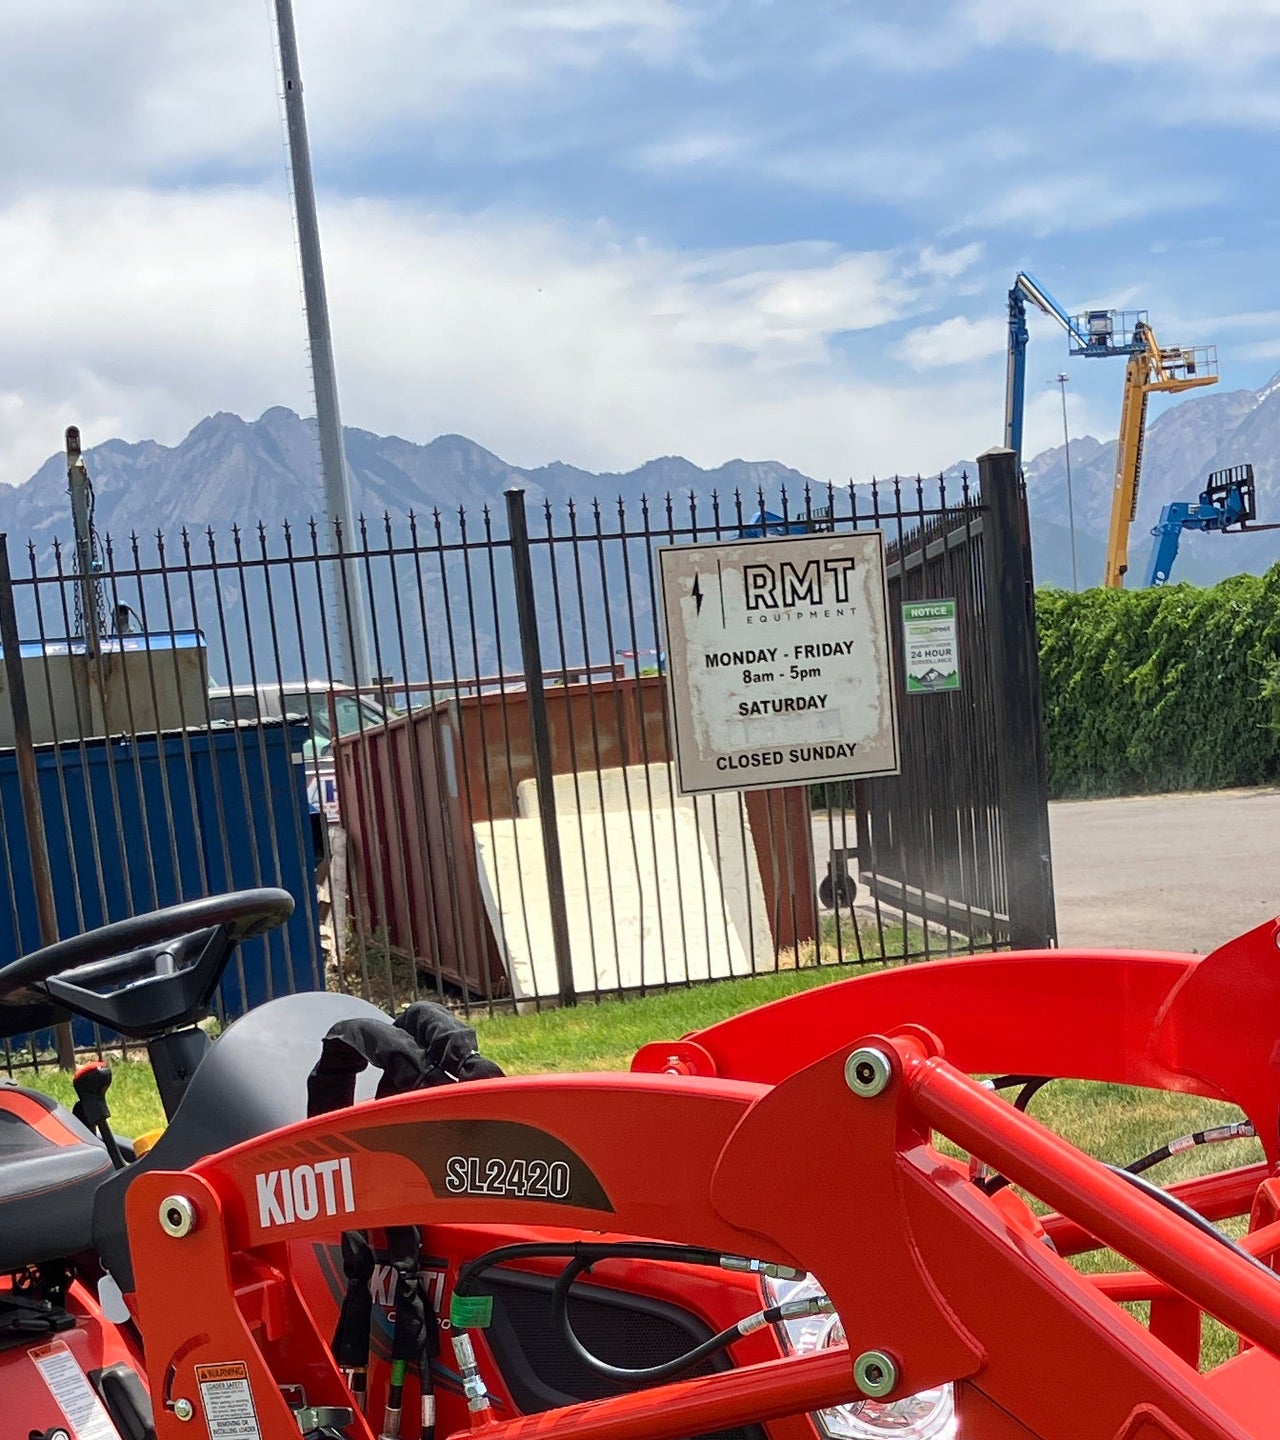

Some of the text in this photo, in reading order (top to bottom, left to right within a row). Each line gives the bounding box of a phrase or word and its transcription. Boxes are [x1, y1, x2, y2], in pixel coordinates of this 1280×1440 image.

[742, 556, 856, 611] RMT
[746, 607, 857, 625] EQUIPMENT
[910, 606, 948, 617] NOTICE
[705, 648, 778, 668] MONDAY
[794, 641, 855, 660] FRIDAY
[911, 648, 952, 659] 24 HOUR
[742, 668, 775, 685] 8am
[789, 665, 822, 683] 5pm
[738, 694, 829, 717] SATURDAY
[716, 743, 858, 771] CLOSED SUNDAY
[254, 1156, 571, 1229] KIOTI SL2420
[369, 1263, 446, 1313] KITI
[208, 1366, 245, 1378] WARNING
